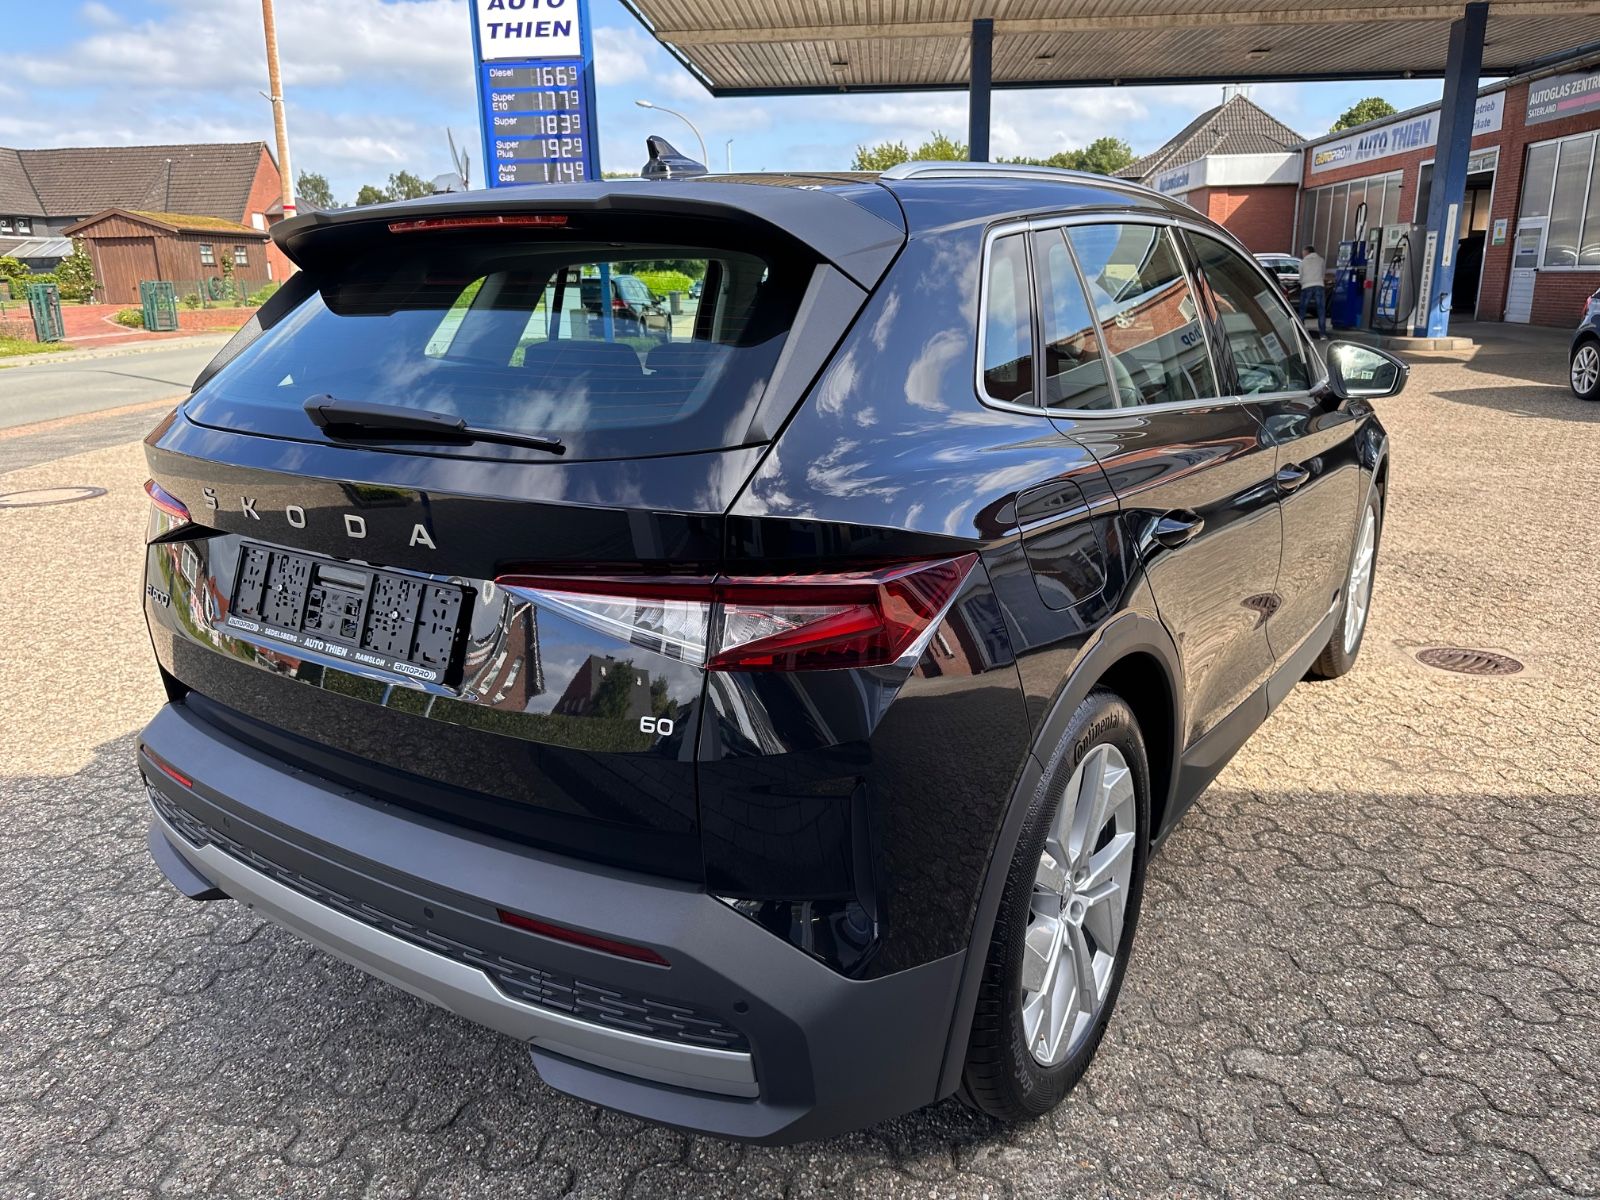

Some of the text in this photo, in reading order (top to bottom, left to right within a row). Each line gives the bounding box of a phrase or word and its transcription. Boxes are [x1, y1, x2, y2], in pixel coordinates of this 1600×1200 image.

[487, 0, 566, 11] AUTO
[486, 20, 572, 39] THIEN
[489, 66, 577, 86] Diesel 1669
[492, 90, 579, 110] Super 1779
[1529, 84, 1571, 106] AUTOGLAS
[492, 103, 508, 111] E10
[1527, 103, 1557, 119] SATERLAND
[494, 114, 581, 135] Super 1839
[496, 138, 583, 158] Super 1929
[1355, 131, 1388, 160] AUTO
[1391, 118, 1432, 151] THIEN
[496, 150, 514, 158] Plus
[498, 163, 517, 172] Auto
[499, 173, 515, 182] Gas
[264, 627, 298, 642] SEDELSBERG
[304, 638, 324, 650] AUTO
[325, 643, 348, 657] THIEN
[354, 652, 386, 667] RAMSLOH
[640, 716, 674, 736] 60
